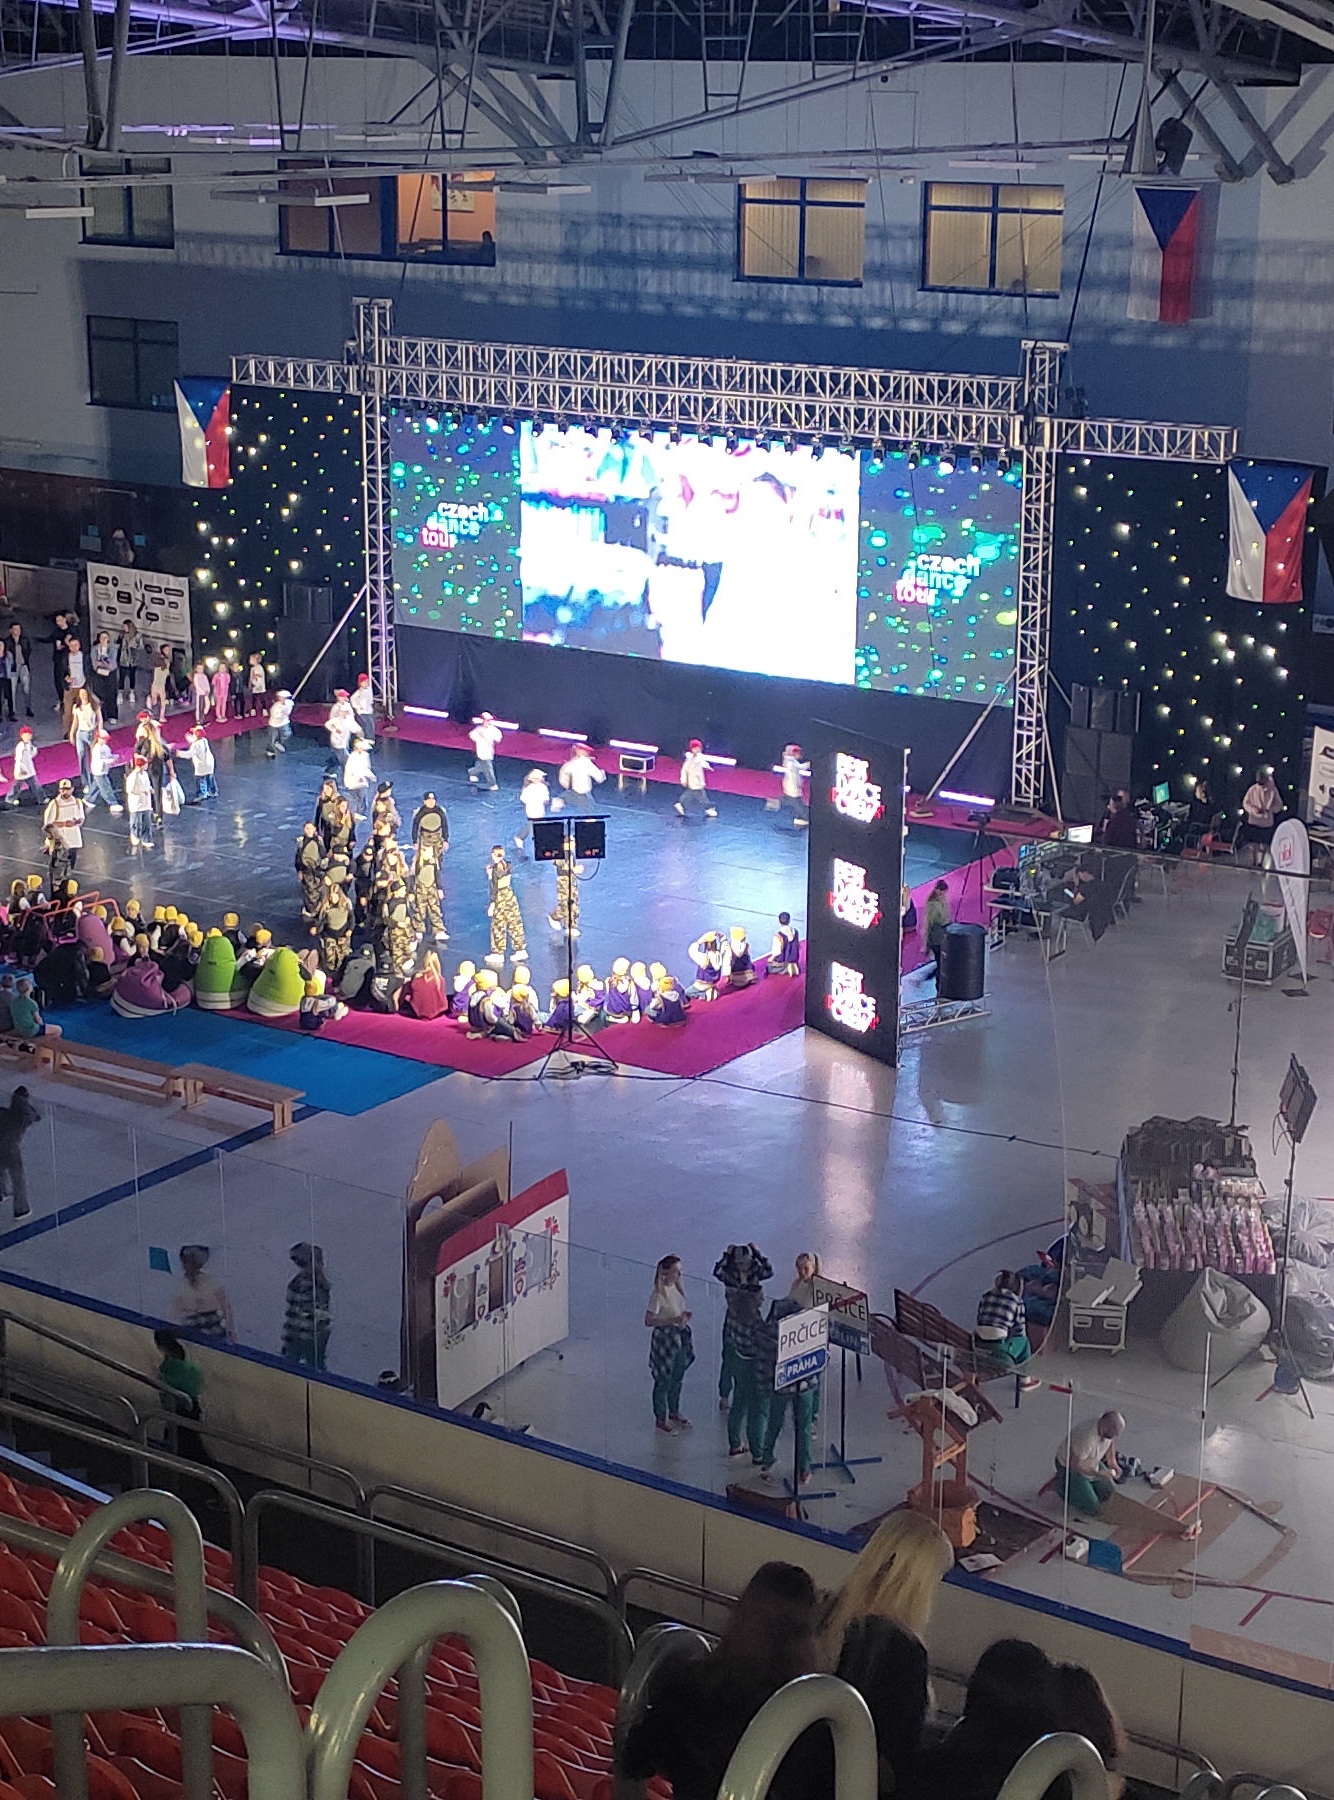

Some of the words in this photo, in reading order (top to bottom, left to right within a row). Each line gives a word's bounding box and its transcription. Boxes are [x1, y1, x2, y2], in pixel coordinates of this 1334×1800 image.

[426, 511, 480, 536] dance
[438, 502, 489, 522] czech
[422, 527, 458, 548] tour
[902, 561, 968, 590] dance
[917, 553, 981, 576] czech
[895, 580, 939, 606] tour
[780, 1318, 827, 1352] PRČICE
[787, 1355, 818, 1378] PRAHA
